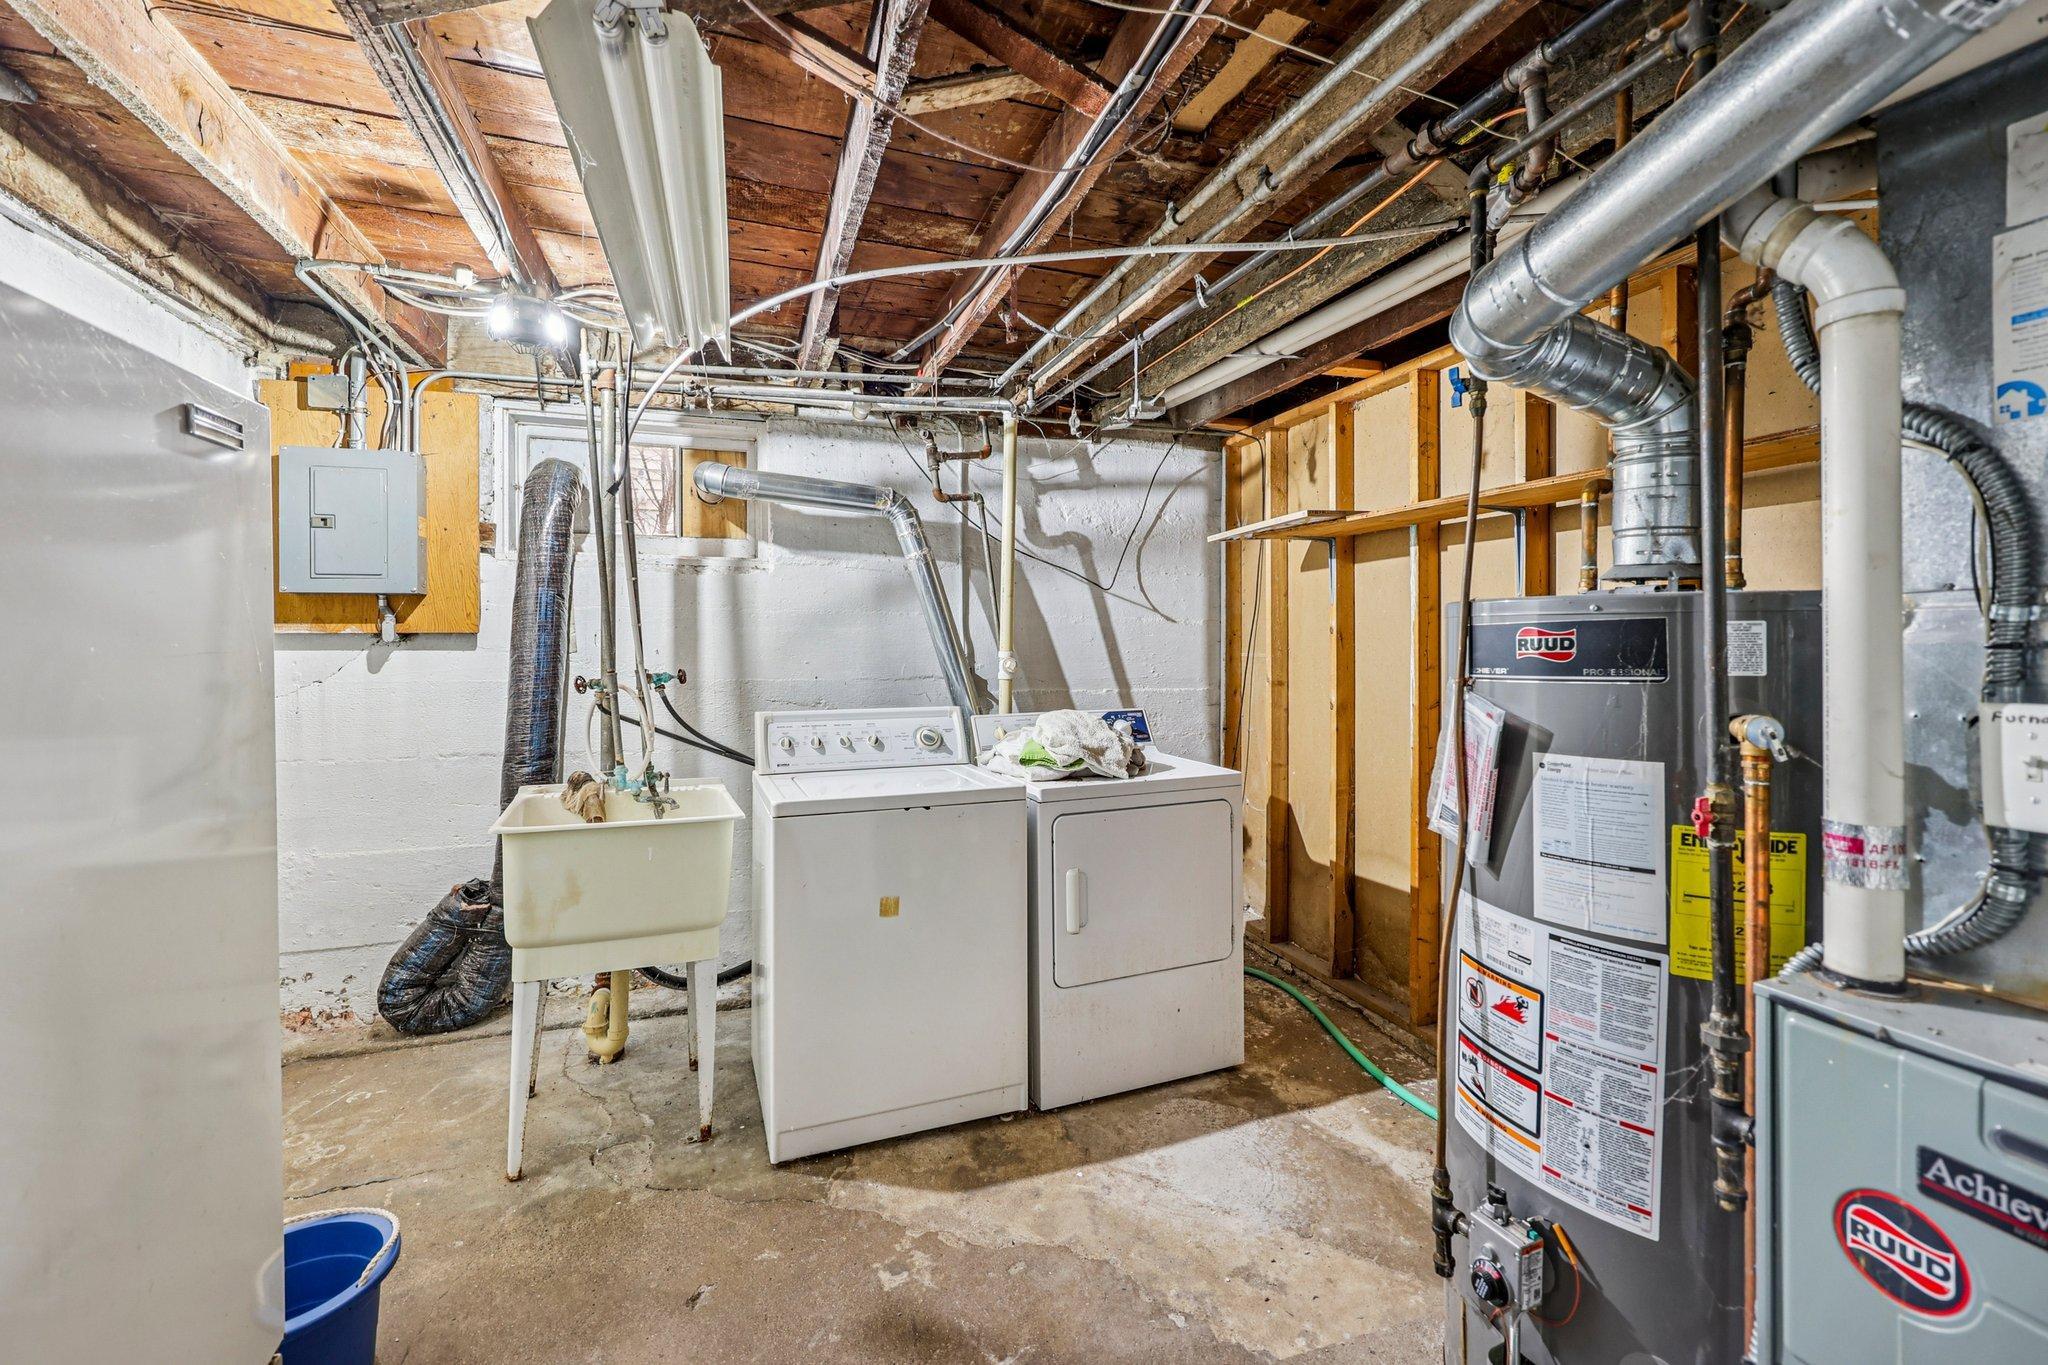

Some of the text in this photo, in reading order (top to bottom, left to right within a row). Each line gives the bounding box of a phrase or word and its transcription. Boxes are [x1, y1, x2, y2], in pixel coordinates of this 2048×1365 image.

[1518, 637, 1575, 651] RUUD
[1924, 1158, 2048, 1230] Achiev
[1850, 1218, 1952, 1282] RUUD
